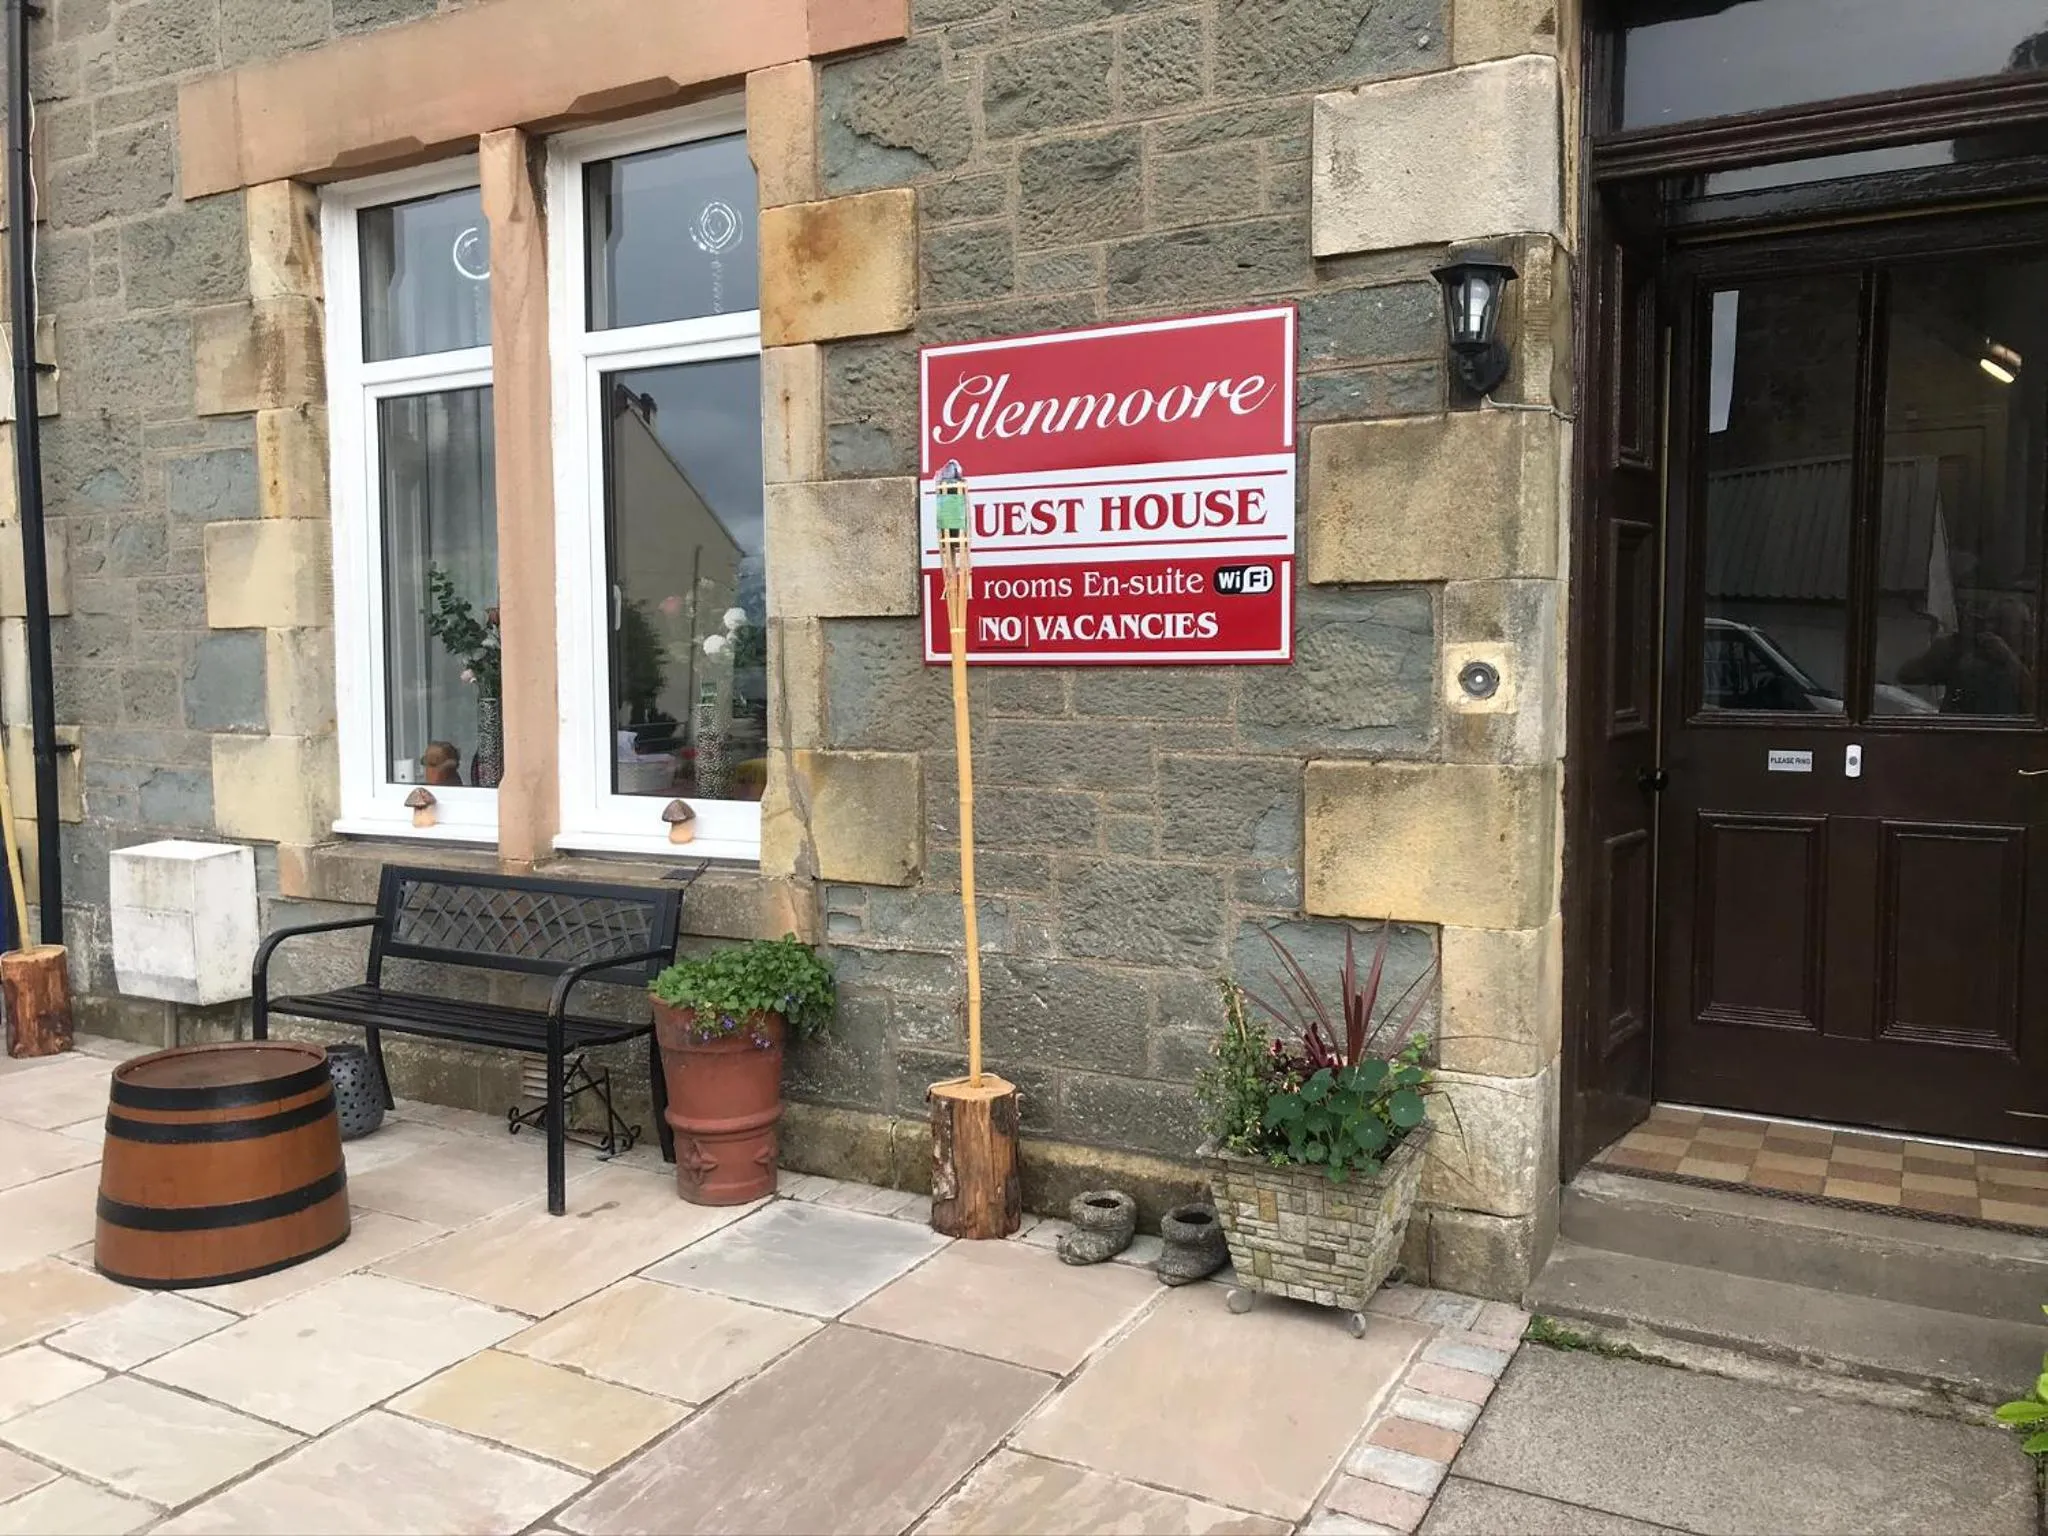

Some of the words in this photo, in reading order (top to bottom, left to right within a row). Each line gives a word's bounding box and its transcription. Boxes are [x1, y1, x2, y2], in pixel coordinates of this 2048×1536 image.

[932, 371, 1276, 444] Glenmoore
[972, 499, 1085, 538] UEST
[1099, 487, 1268, 532] HOUSE
[984, 576, 1073, 600] rooms
[1083, 567, 1204, 598] En-suite
[1218, 570, 1269, 590] WiFi
[981, 615, 1022, 642] NO
[1033, 611, 1220, 641] VACANCIES
[1770, 757, 1794, 765] PLEASE
